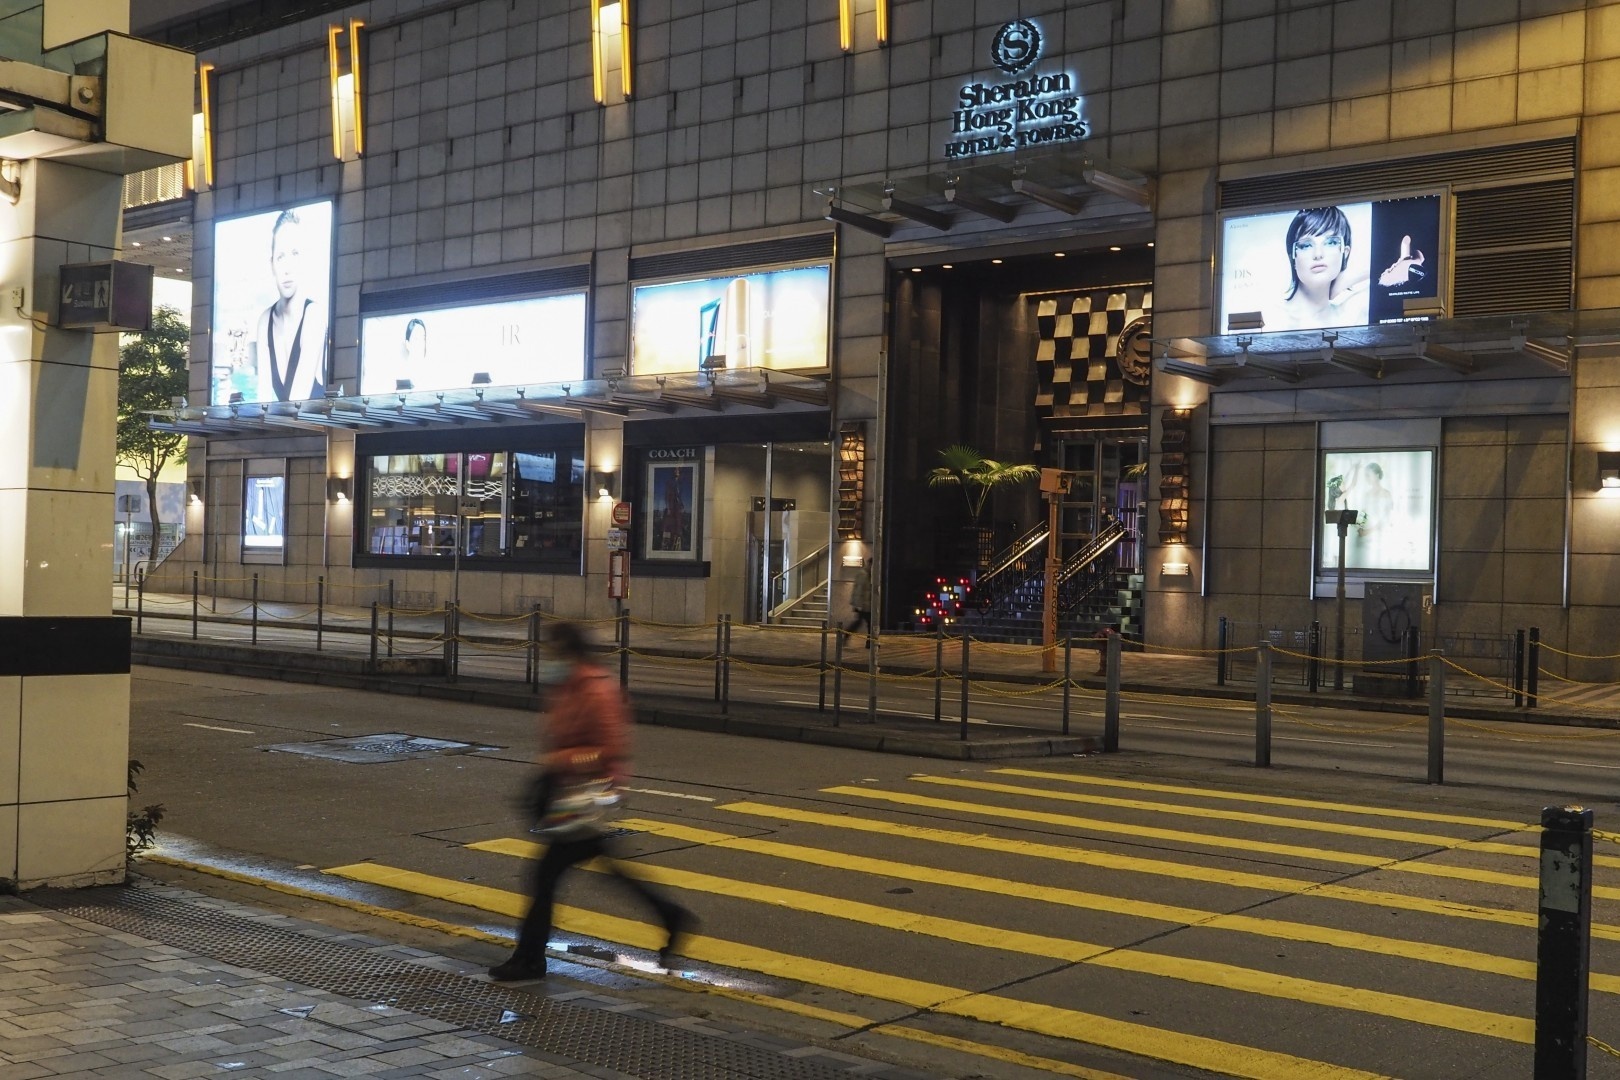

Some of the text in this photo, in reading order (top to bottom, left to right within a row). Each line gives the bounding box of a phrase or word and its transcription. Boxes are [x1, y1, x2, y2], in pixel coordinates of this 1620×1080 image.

[959, 73, 1071, 109] Sheraton
[952, 96, 1080, 134] Hong Kong
[945, 121, 1088, 158] HOTEL & TOWERS
[648, 448, 696, 459] COACH
